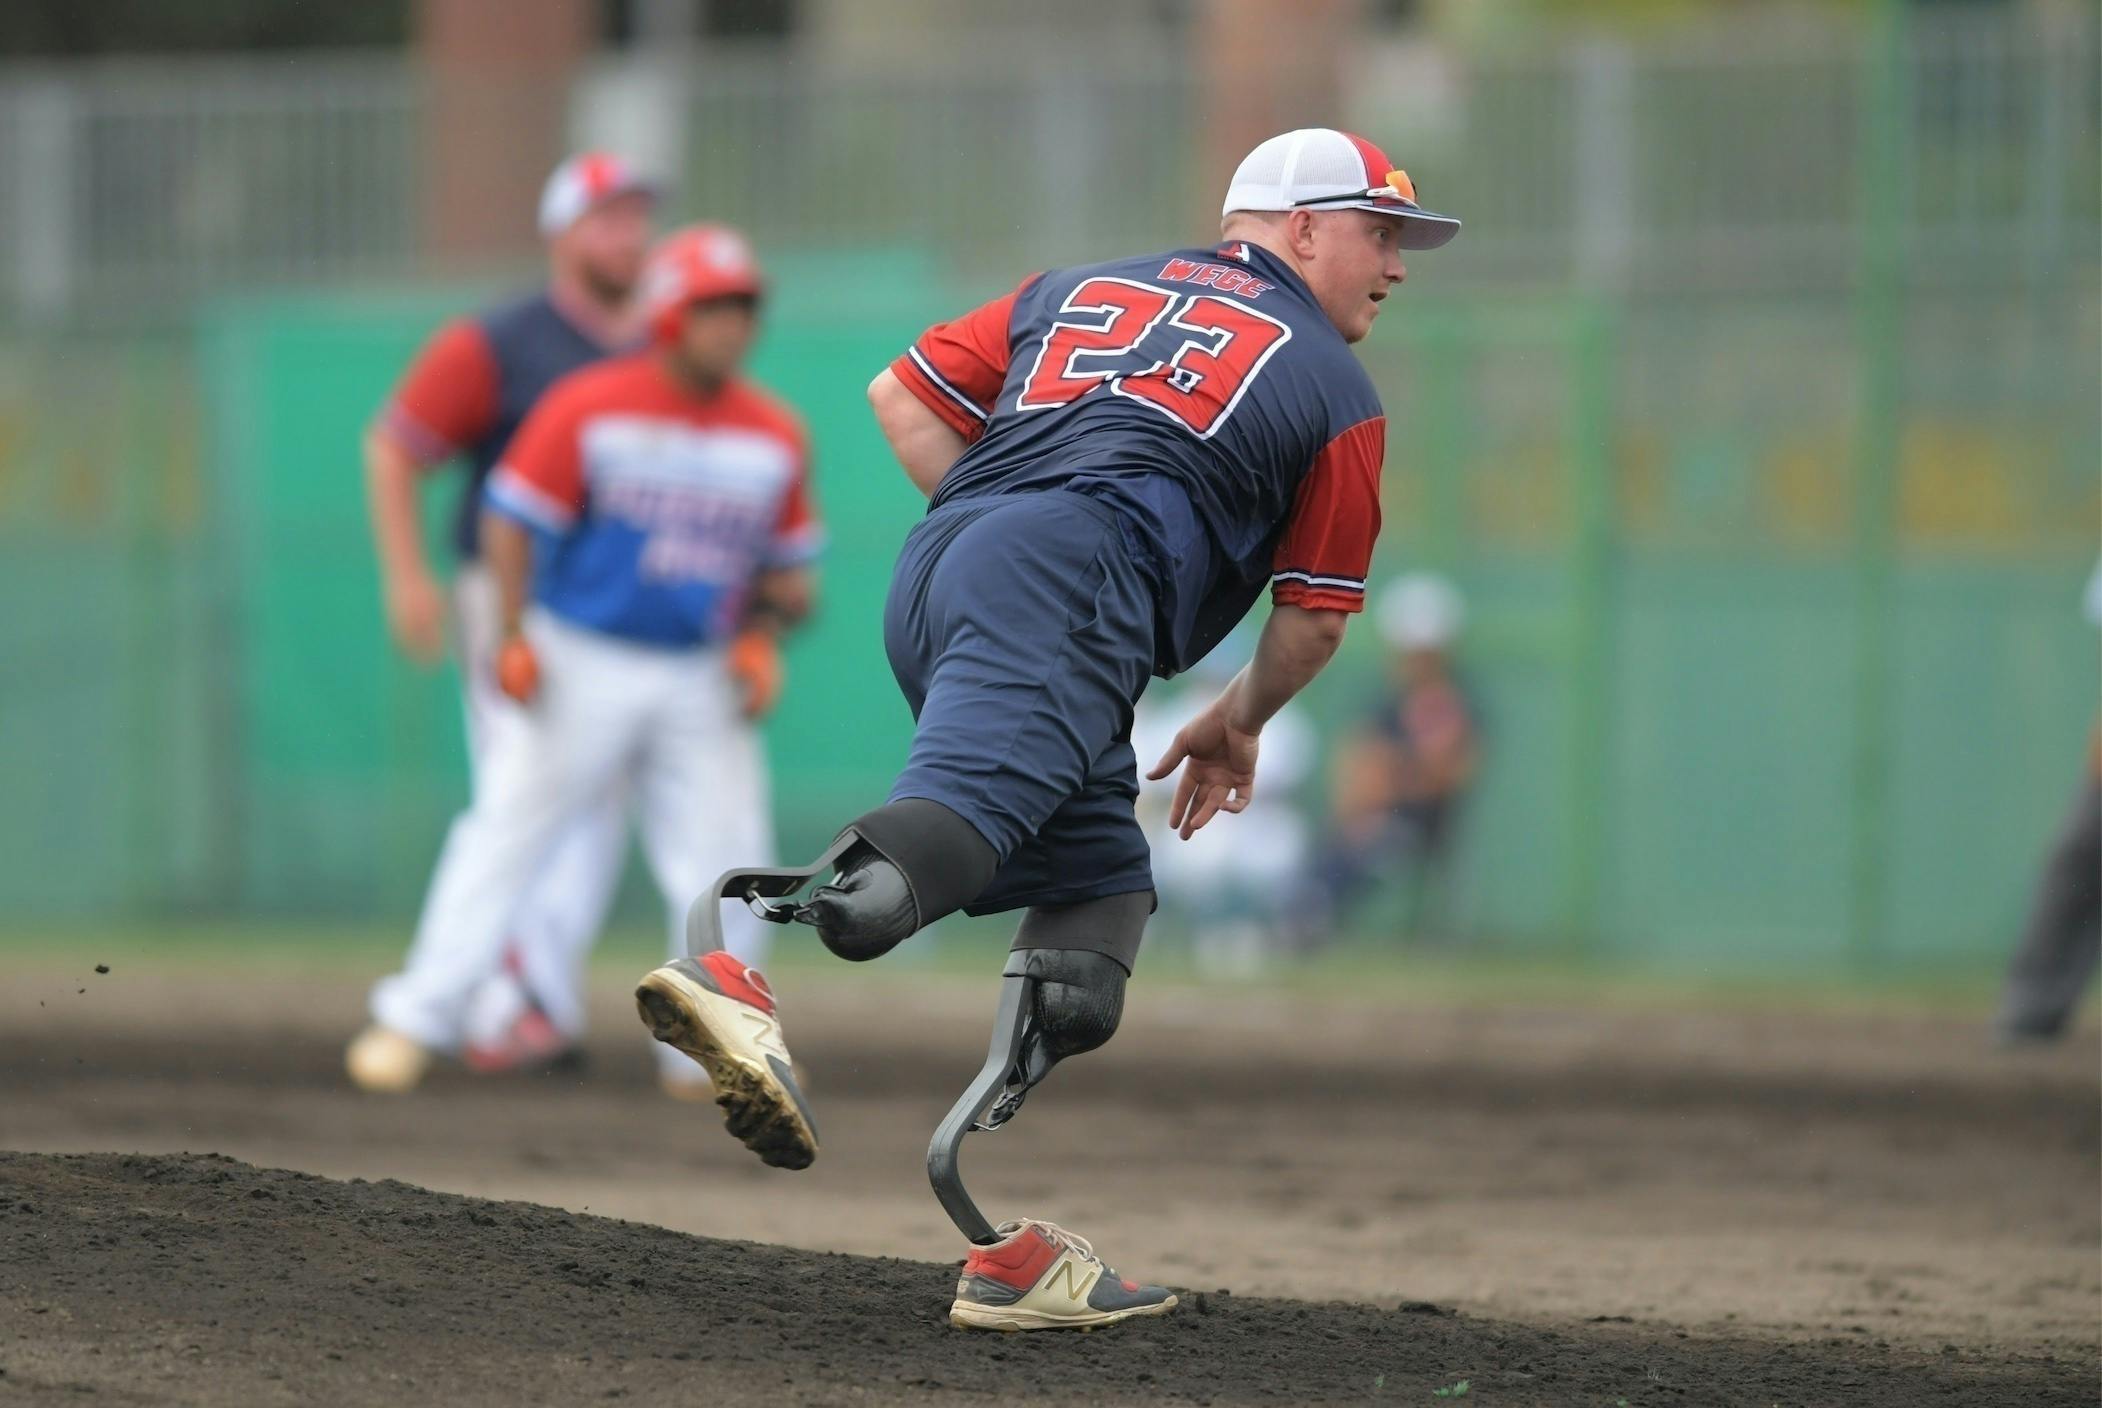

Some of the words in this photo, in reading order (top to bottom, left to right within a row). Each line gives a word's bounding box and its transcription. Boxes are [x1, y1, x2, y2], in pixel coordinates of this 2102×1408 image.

[1157, 257, 1276, 299] WEGE
[1016, 276, 1292, 440] 23
[1042, 1259, 1096, 1301] N
